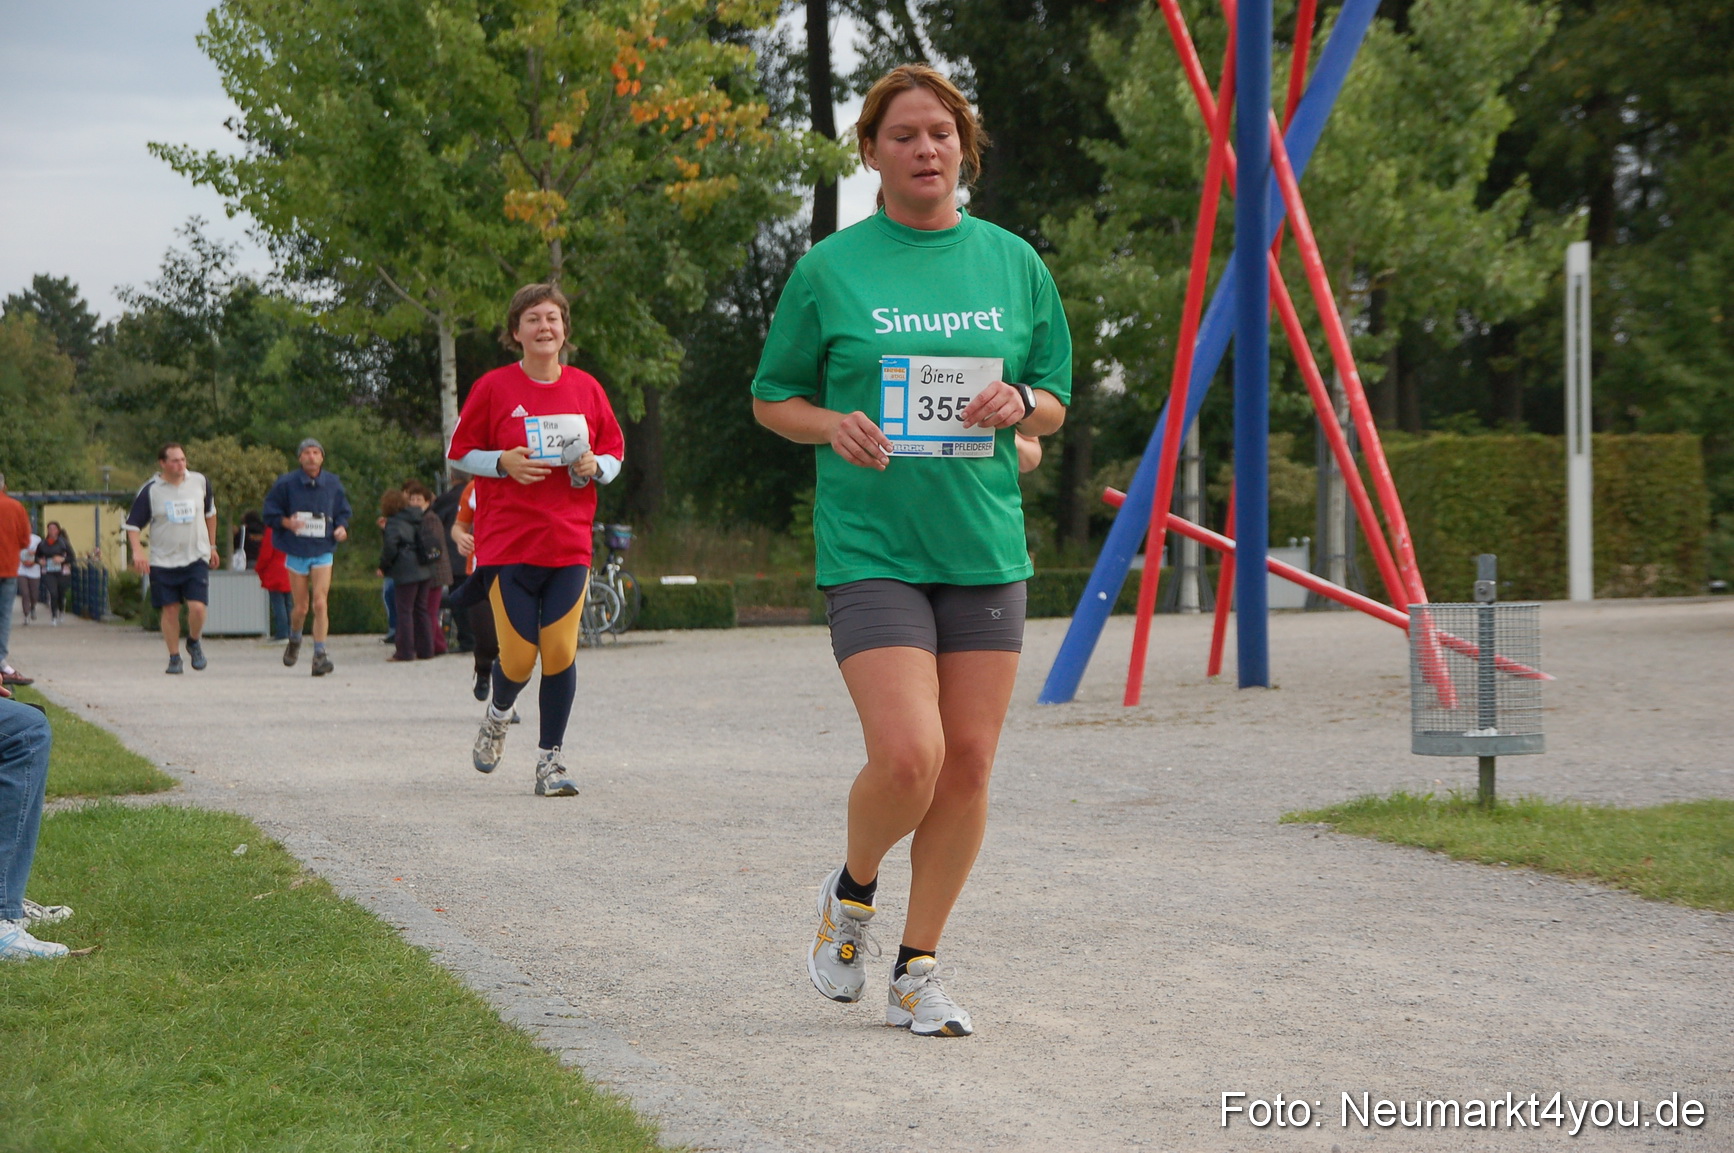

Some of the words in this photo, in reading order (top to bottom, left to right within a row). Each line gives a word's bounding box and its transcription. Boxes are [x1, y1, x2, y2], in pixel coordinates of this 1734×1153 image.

[920, 364, 965, 385] Biene
[543, 421, 558, 430] Rita
[954, 443, 993, 451] PFLEIDERER
[841, 944, 854, 959] S
